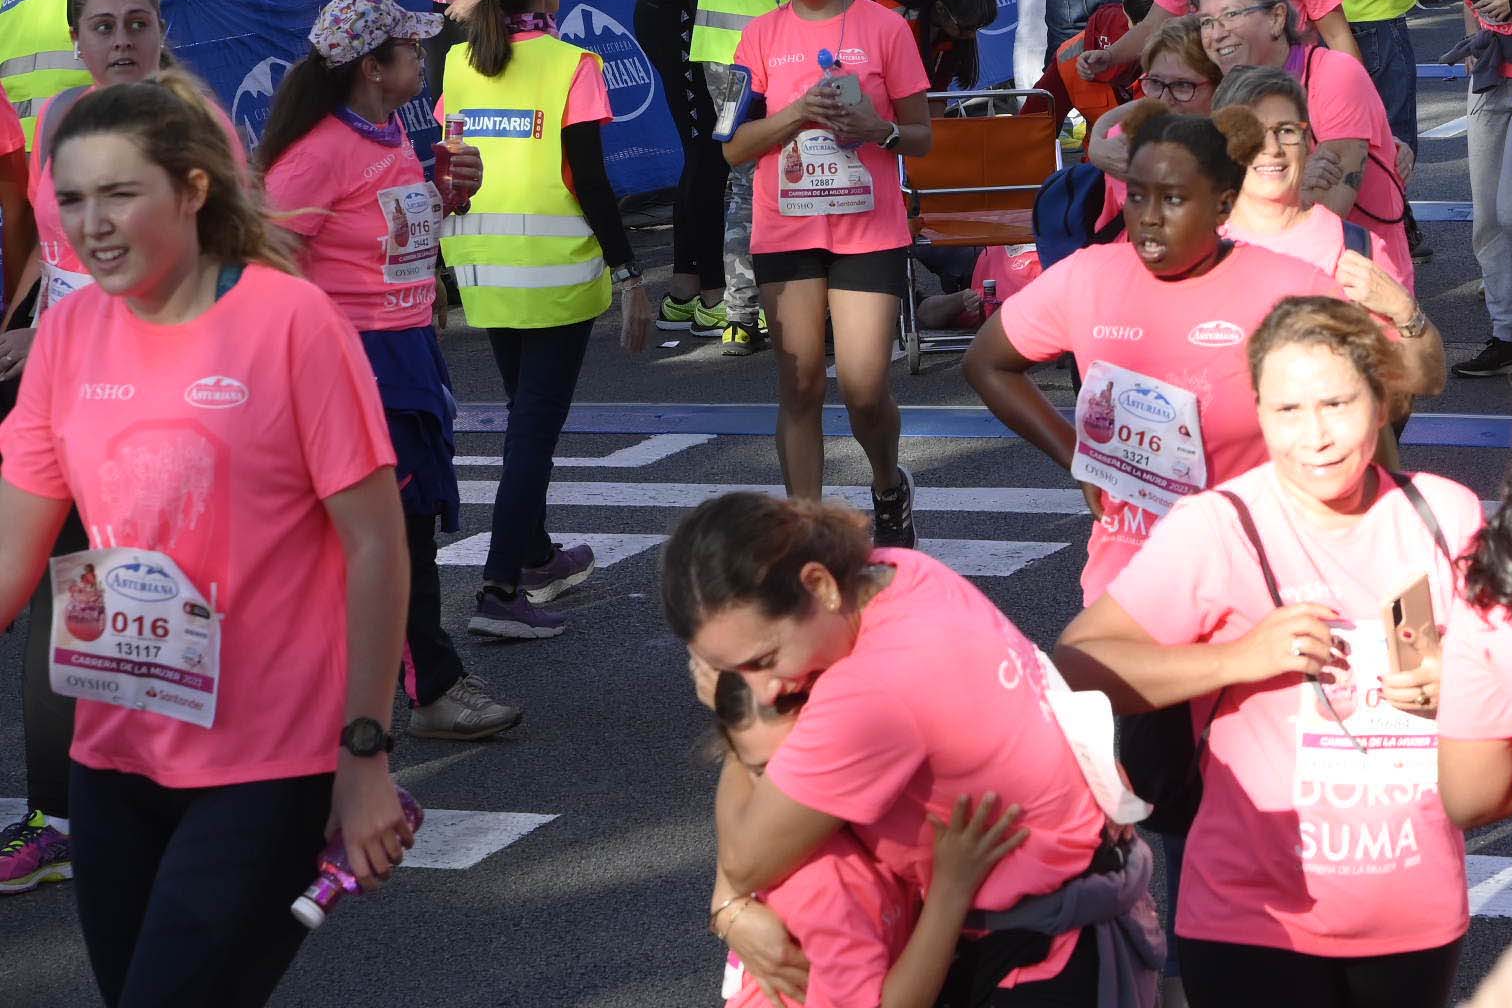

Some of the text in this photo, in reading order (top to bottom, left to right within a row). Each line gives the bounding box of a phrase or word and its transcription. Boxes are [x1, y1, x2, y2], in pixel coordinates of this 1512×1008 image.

[768, 53, 805, 68] OYSHO
[462, 116, 531, 132] OLUNTARIS
[363, 152, 396, 179] OYSHO
[806, 162, 838, 176] 016
[810, 178, 835, 187] 12887
[786, 202, 814, 210] OYSHO
[836, 199, 866, 207] Santander
[410, 219, 430, 236] 016
[1092, 325, 1143, 342] OYSHO
[1118, 425, 1162, 453] 016
[1122, 448, 1150, 467] 3321
[1085, 463, 1119, 486] OYSHO
[1089, 449, 1121, 468] CARRERA
[1121, 462, 1134, 473] DE
[1133, 468, 1143, 477] LA
[1142, 471, 1169, 488] MUJER
[112, 573, 174, 595] ASTURIANA
[111, 611, 170, 639] 016
[116, 642, 162, 659] 13117
[70, 653, 118, 670] CARRERA
[119, 662, 133, 672] DE
[135, 663, 148, 674] LA
[150, 666, 181, 682] MUJER
[66, 674, 120, 693] OYSHO
[1295, 817, 1420, 862] SUMA
